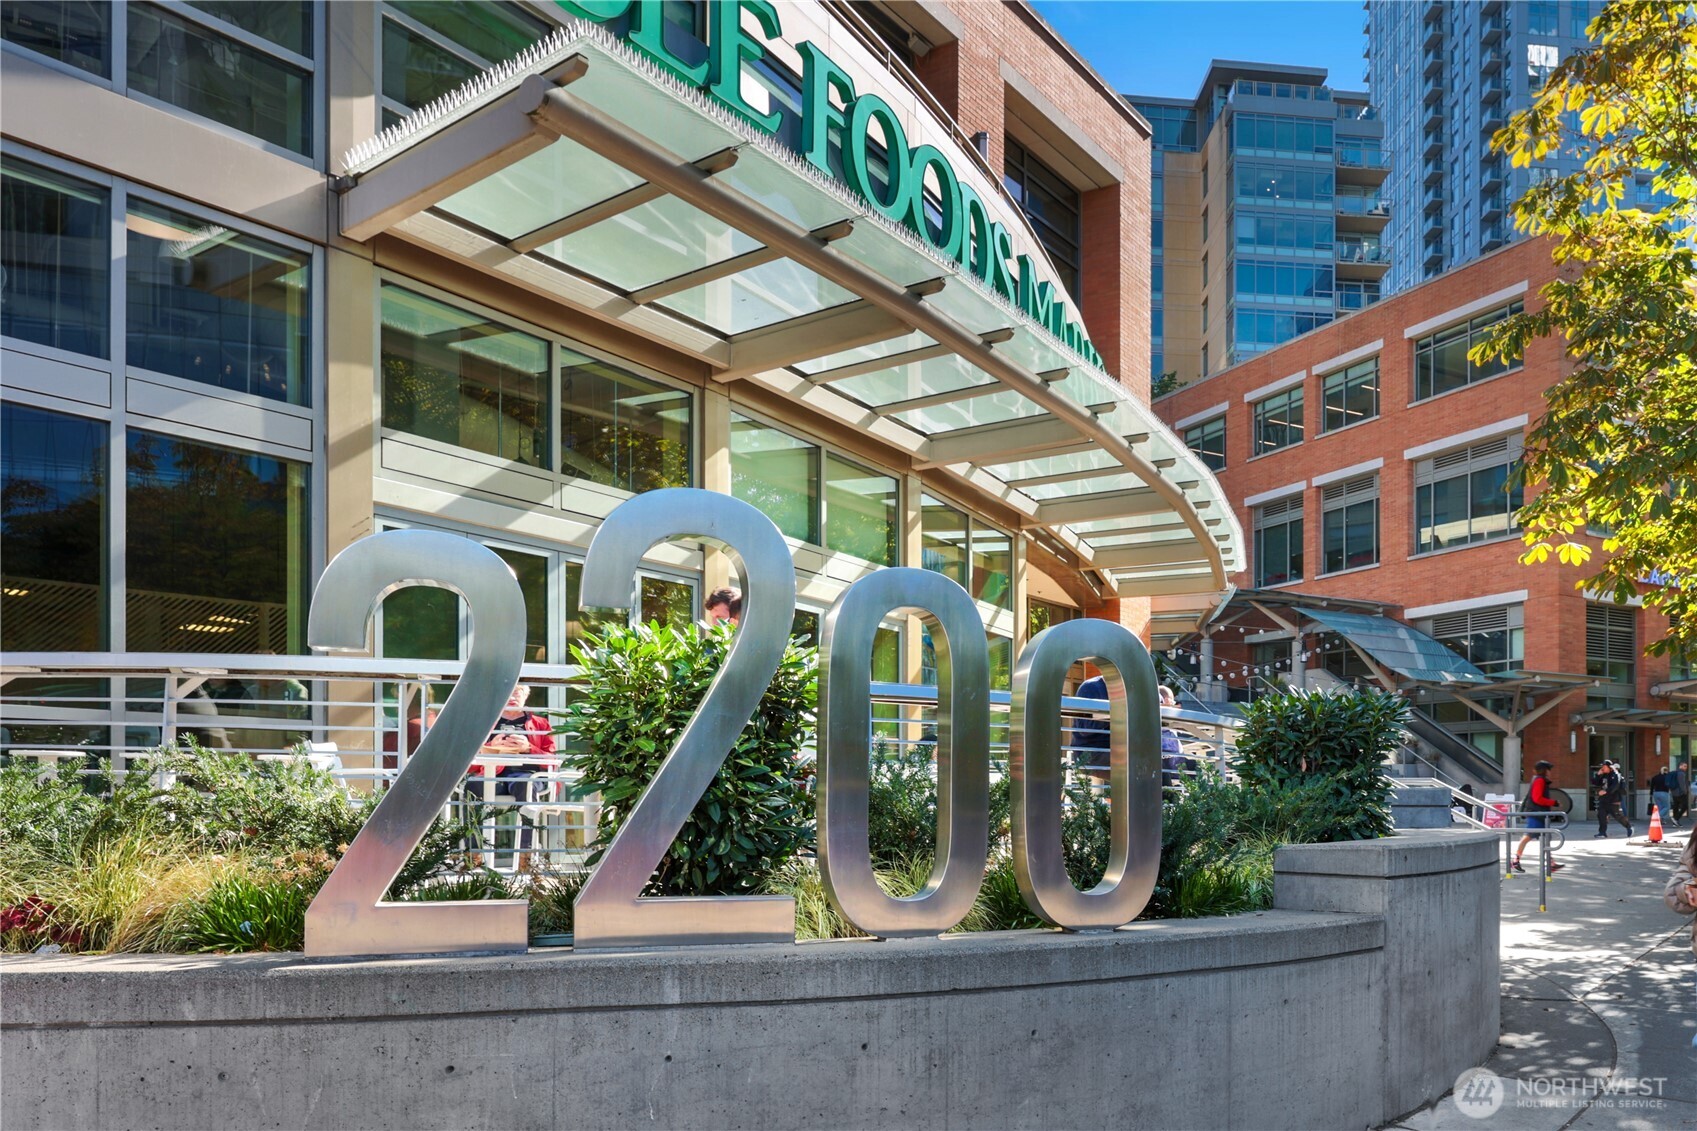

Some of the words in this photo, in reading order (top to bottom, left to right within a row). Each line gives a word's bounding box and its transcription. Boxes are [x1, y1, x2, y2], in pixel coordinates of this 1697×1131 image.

[546, 0, 784, 134] LE
[795, 40, 1017, 310] FOODS
[304, 486, 1163, 958] 2200
